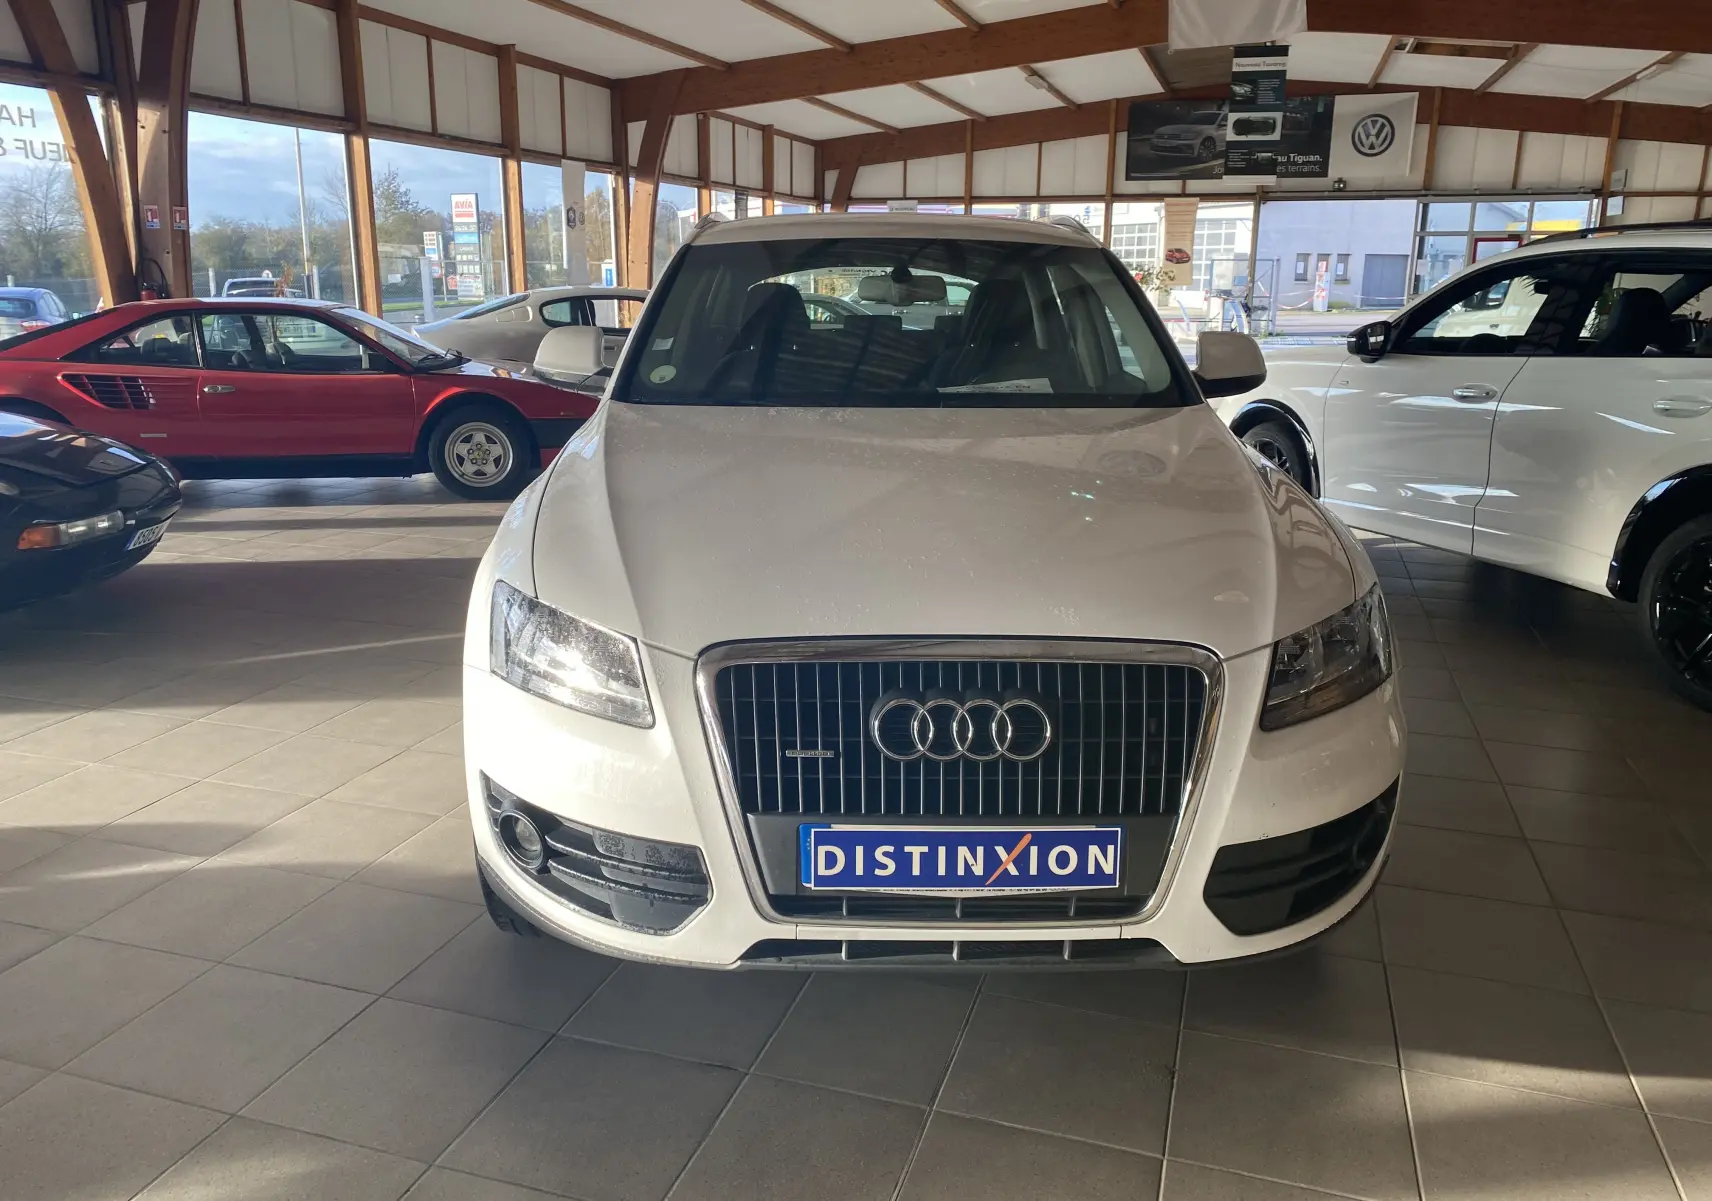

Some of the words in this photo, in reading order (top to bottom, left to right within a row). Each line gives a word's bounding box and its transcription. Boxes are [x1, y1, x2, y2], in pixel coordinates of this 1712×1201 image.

[1288, 153, 1323, 164] Tiguan.
[1288, 163, 1322, 172] terrains.
[817, 836, 1115, 884] DISTINXION
